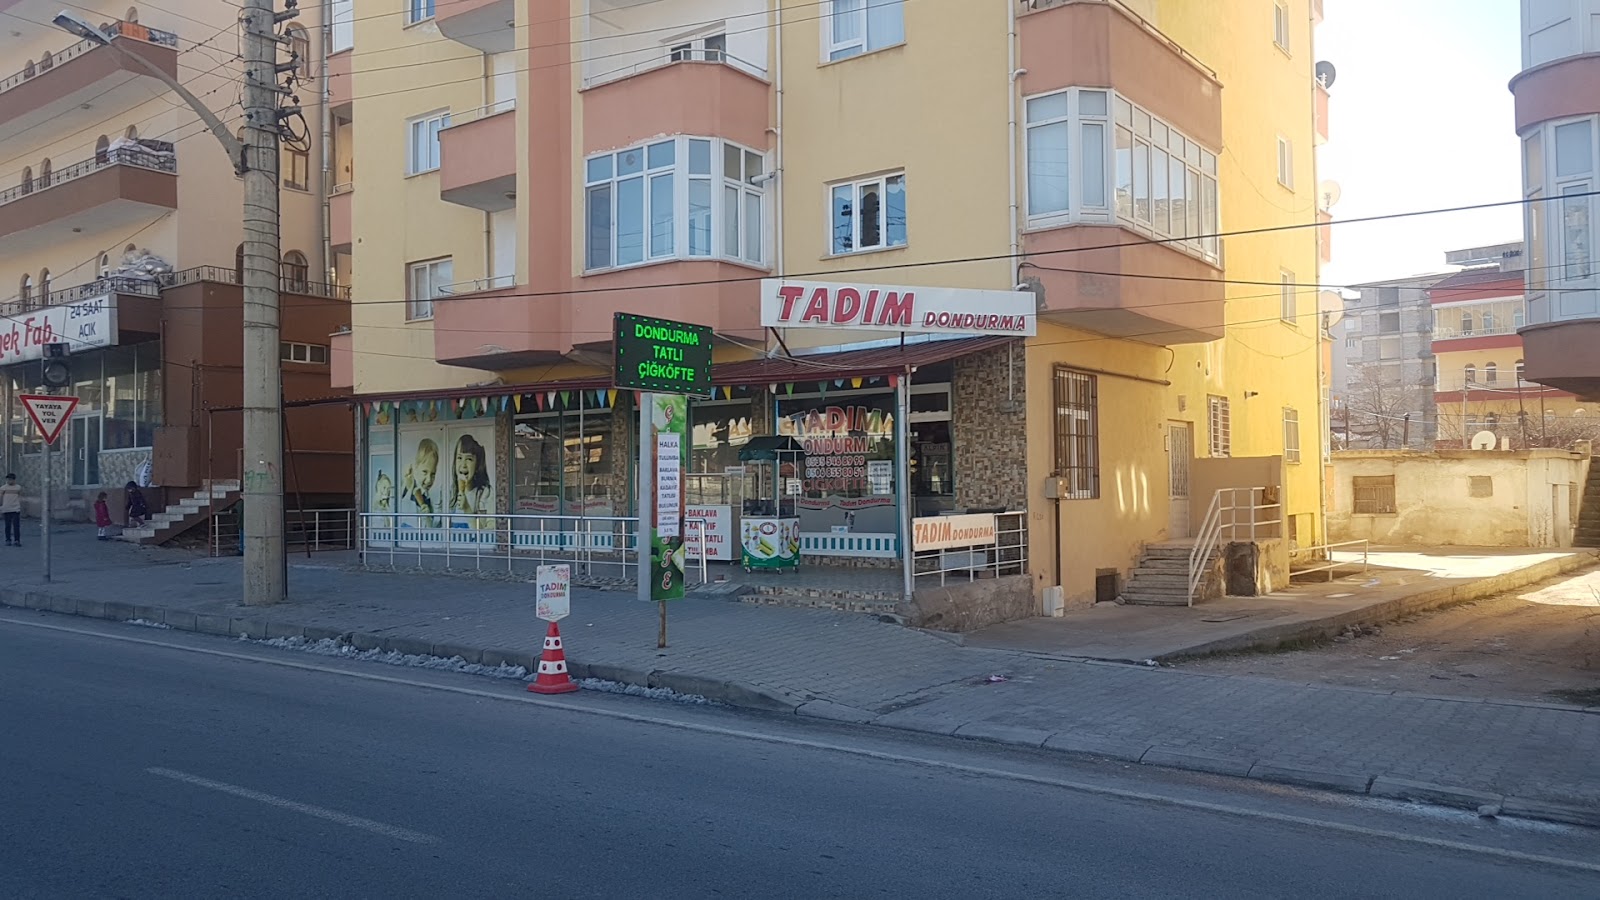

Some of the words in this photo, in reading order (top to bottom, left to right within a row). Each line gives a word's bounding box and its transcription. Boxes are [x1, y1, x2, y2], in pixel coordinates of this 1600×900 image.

[70, 305, 80, 319] 24
[83, 299, 103, 317] SAAT
[778, 286, 916, 325] TADIM
[924, 312, 1026, 330] DONDURMA
[24, 315, 58, 347] Fab.
[79, 322, 97, 340] AÇIK
[635, 324, 699, 345] DONDURMA
[653, 345, 683, 361] TATLI
[638, 360, 695, 381] ÇİĞKÖFTE
[790, 405, 882, 434] TADIM
[803, 436, 879, 456] ONDURMA
[805, 457, 826, 467] 0535
[853, 455, 865, 466] 99
[805, 467, 826, 478] 0506
[688, 509, 718, 518] BAKLAVA
[689, 521, 717, 531] KAYIF
[915, 522, 951, 544] TADIM
[953, 526, 994, 541] DONDURMA
[705, 535, 723, 543] TATLI
[540, 582, 567, 592] TADIM
